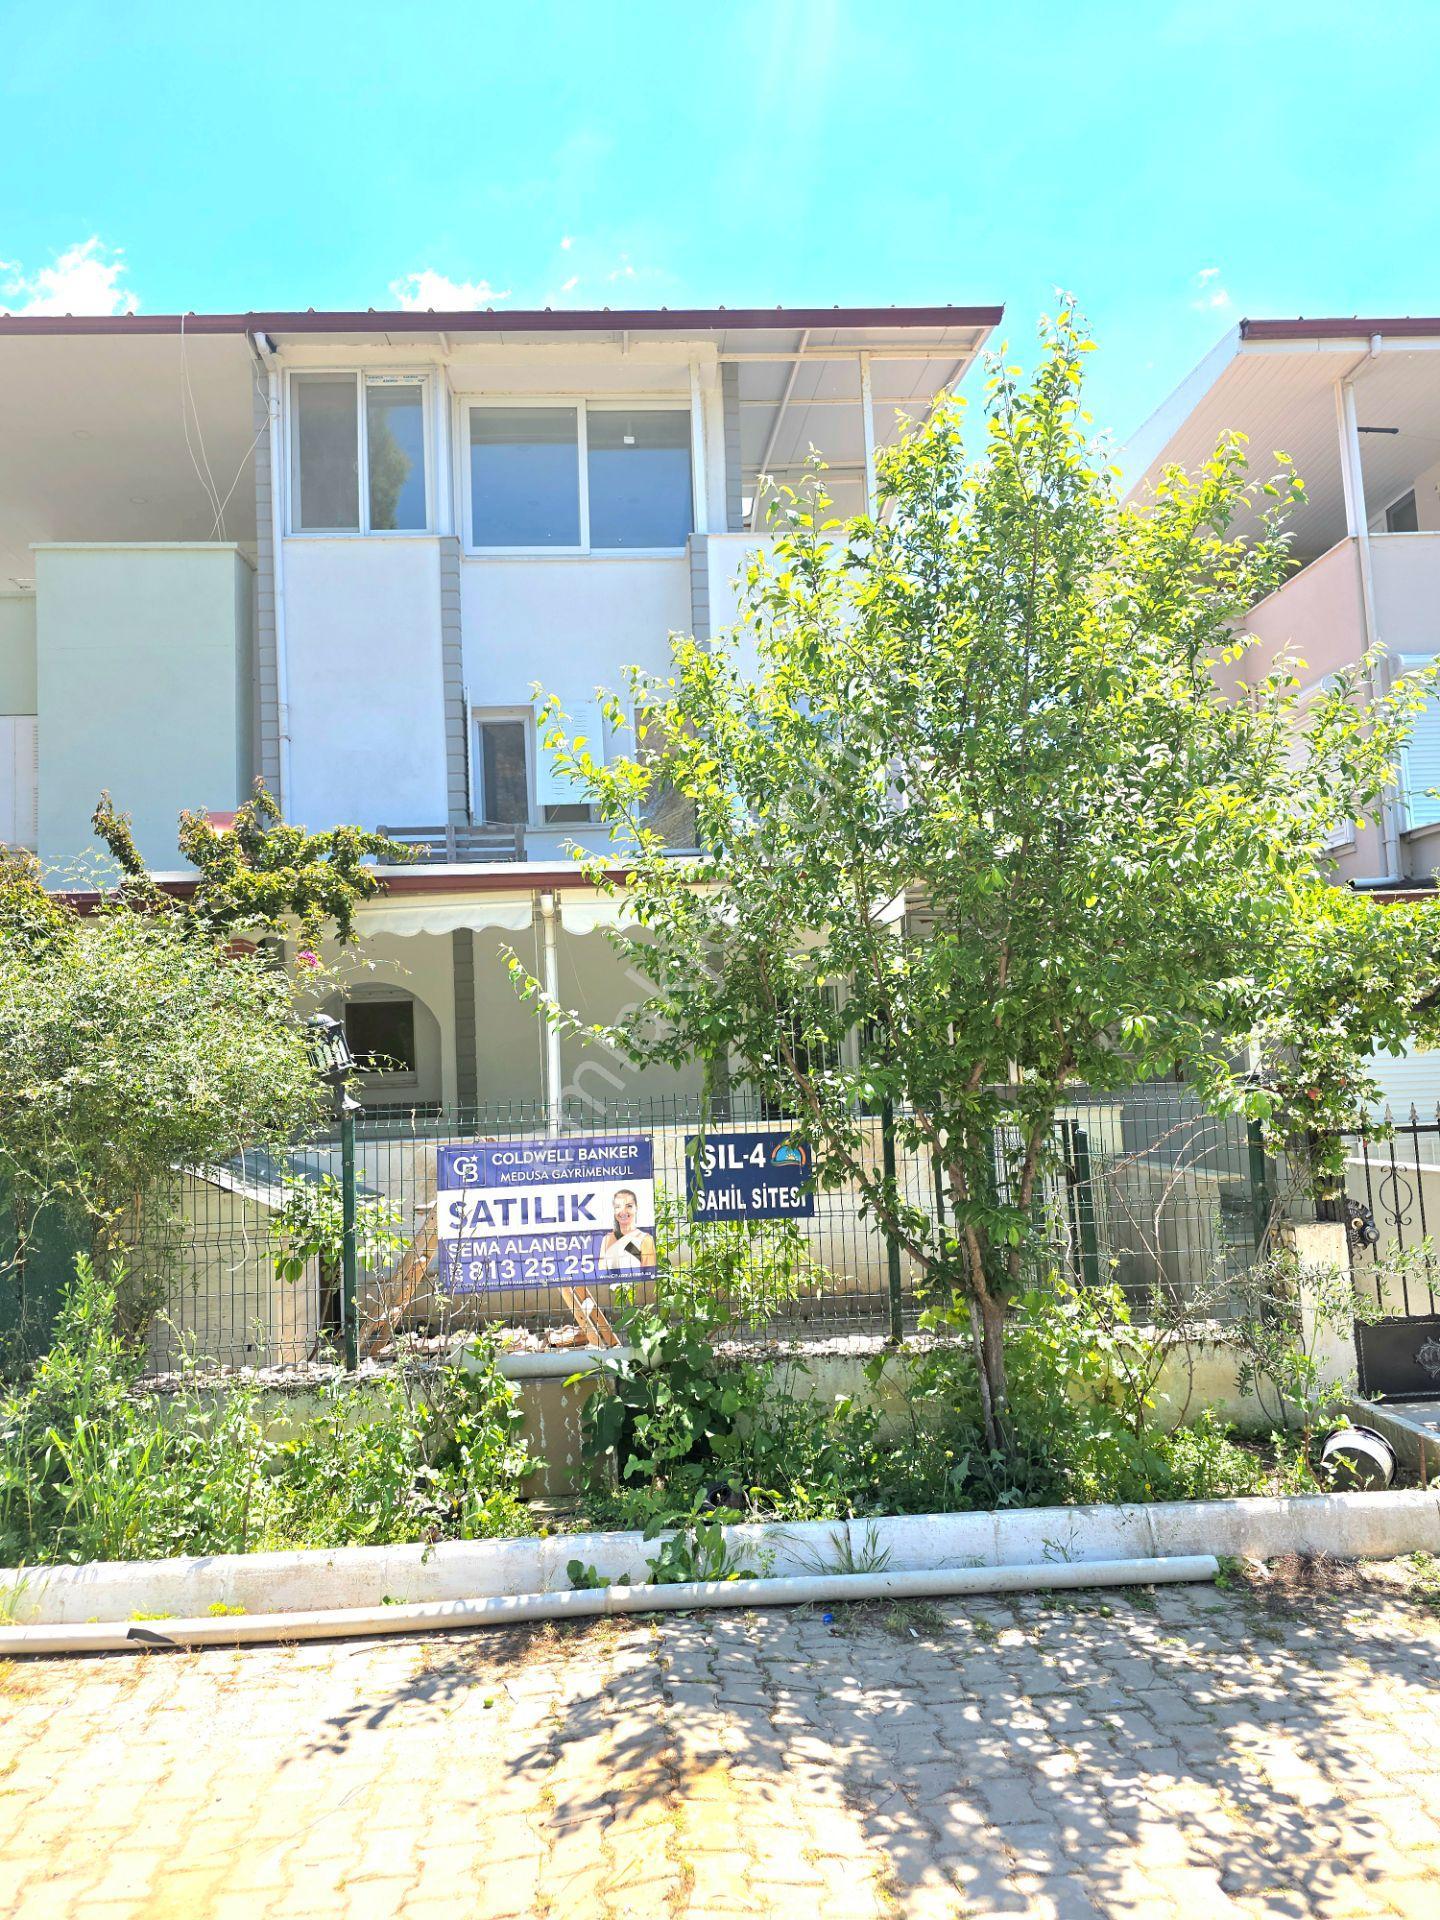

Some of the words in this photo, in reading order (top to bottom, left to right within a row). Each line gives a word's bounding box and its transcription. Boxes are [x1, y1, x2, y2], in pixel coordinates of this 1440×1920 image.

[491, 1149, 575, 1166] COLDWELL
[578, 1145, 639, 1161] BANKER
[500, 1168, 549, 1183] MEDUSA
[551, 1165, 634, 1180] GAYRİMENKUL
[697, 1183, 747, 1211] SAHİL
[449, 1193, 597, 1230] SATILIK
[449, 1240, 501, 1258] SEMA
[504, 1235, 592, 1255] ALANBAY
[469, 1259, 516, 1281] 813
[524, 1257, 556, 1279] 25
[564, 1254, 595, 1275] 25
